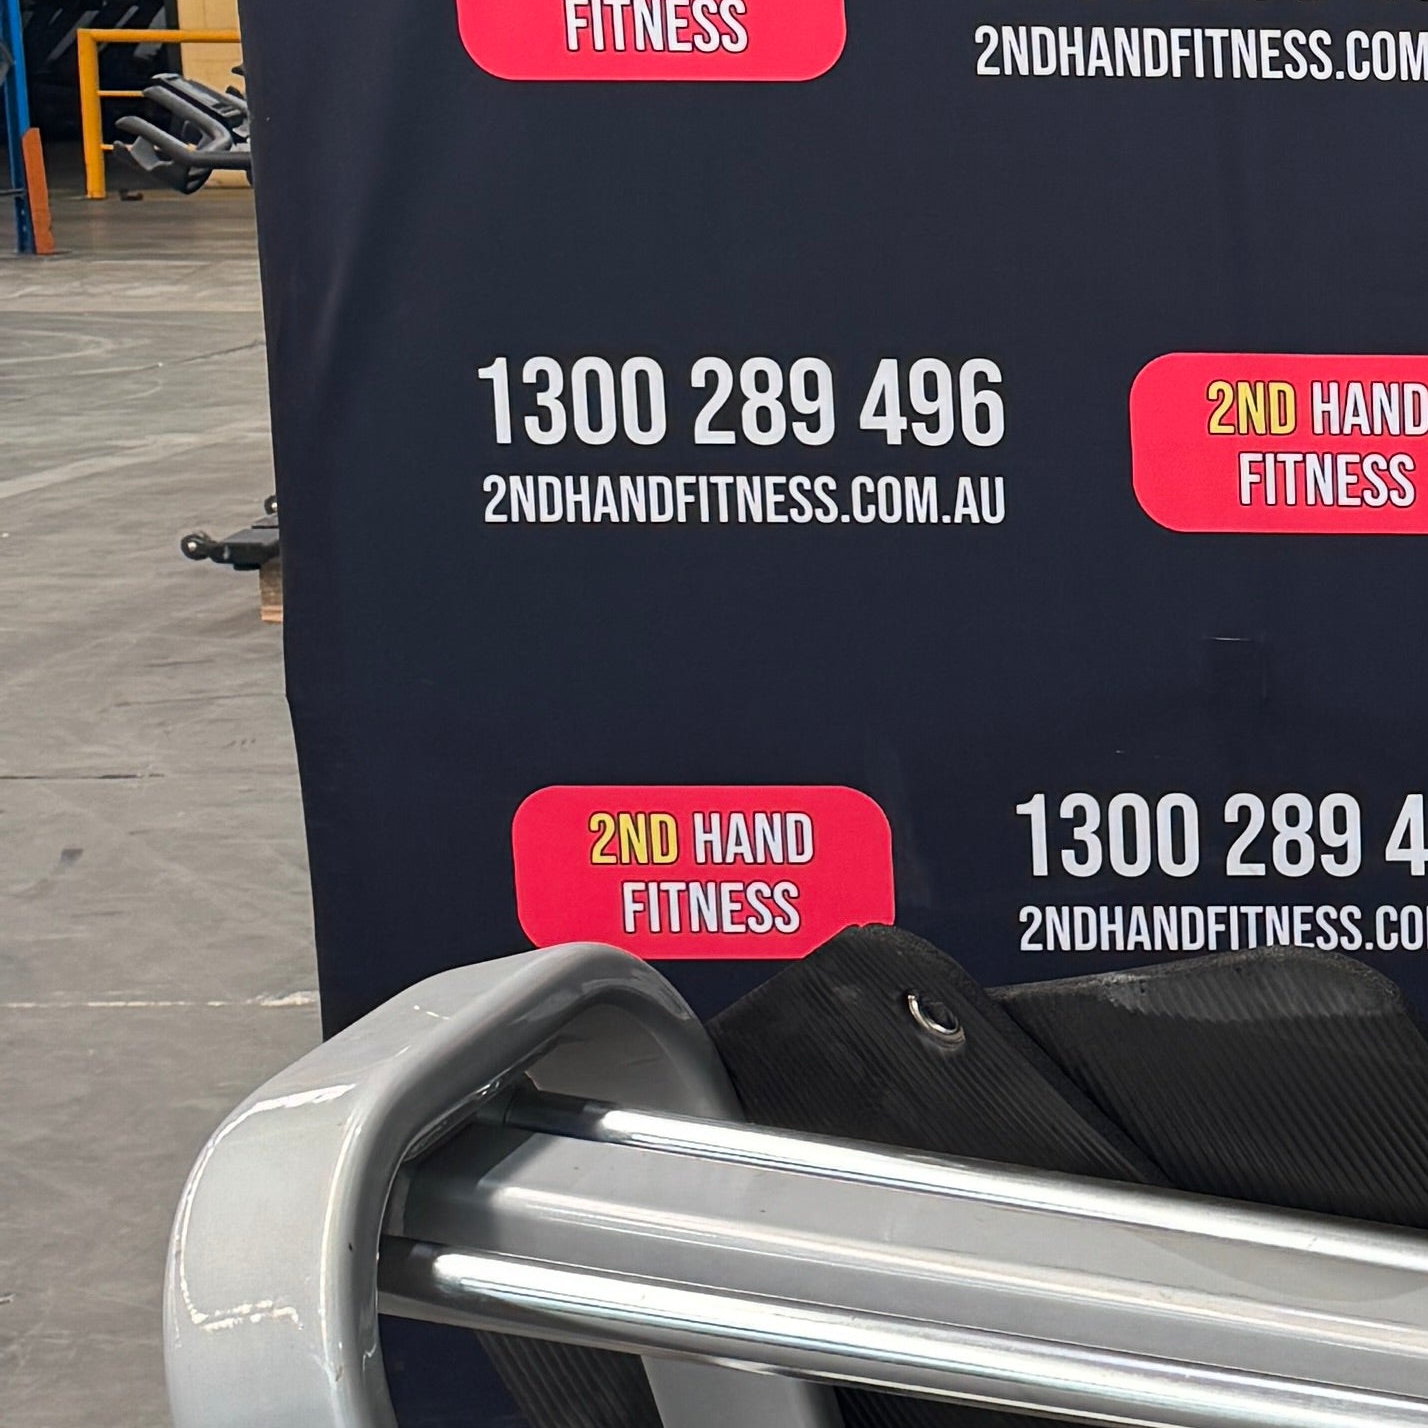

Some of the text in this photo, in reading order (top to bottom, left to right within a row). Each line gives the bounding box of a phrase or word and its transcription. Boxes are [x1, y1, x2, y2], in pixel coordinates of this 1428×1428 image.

[477, 356, 1005, 447] 1300 289 496
[1208, 380, 1296, 434] 2ND
[482, 474, 1006, 524] 2NDHANDFITNESS.COM.AU
[1239, 452, 1415, 507] FITNESS
[589, 812, 814, 864] 2ND HAND
[1016, 792, 1200, 878] 1300
[1224, 792, 1362, 877] 289
[623, 881, 800, 933] FITNESS
